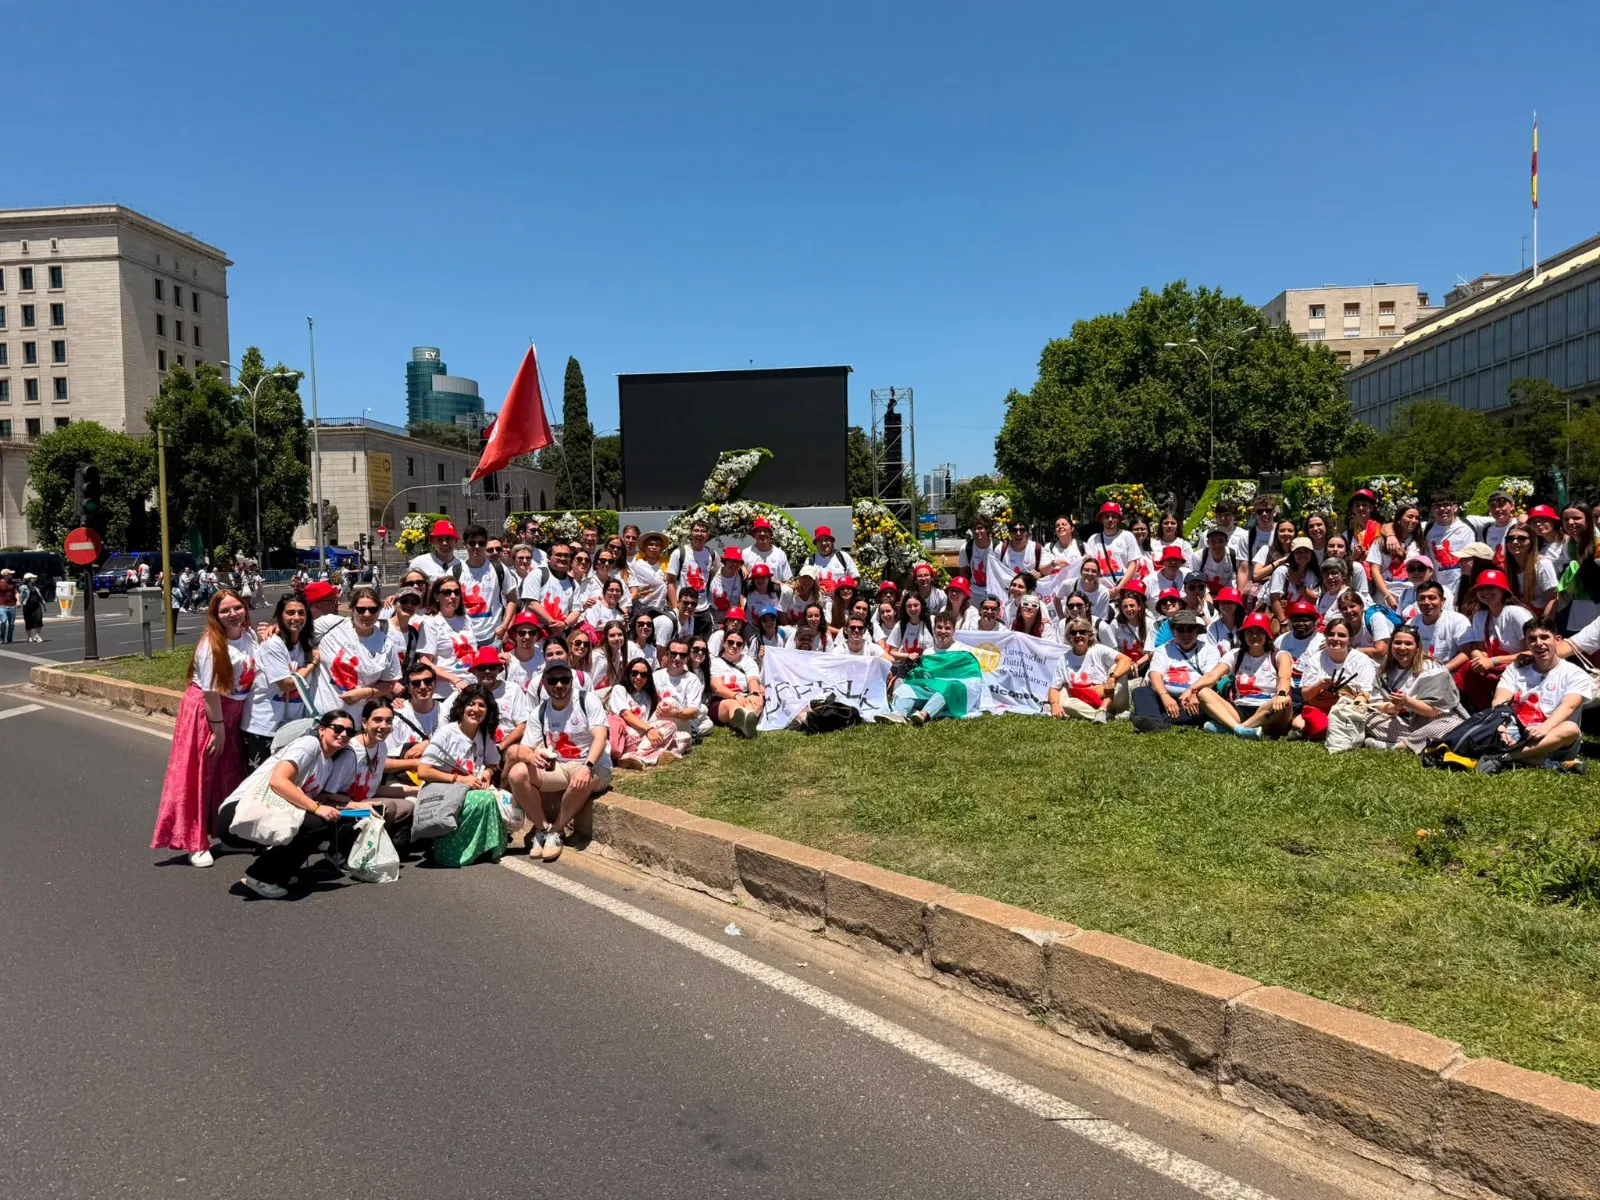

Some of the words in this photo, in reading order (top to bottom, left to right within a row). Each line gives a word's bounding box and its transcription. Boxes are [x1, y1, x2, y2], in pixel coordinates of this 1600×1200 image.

[425, 351, 436, 359] EY
[1004, 646, 1047, 665] Universidad
[1002, 656, 1033, 672] Pontifcia
